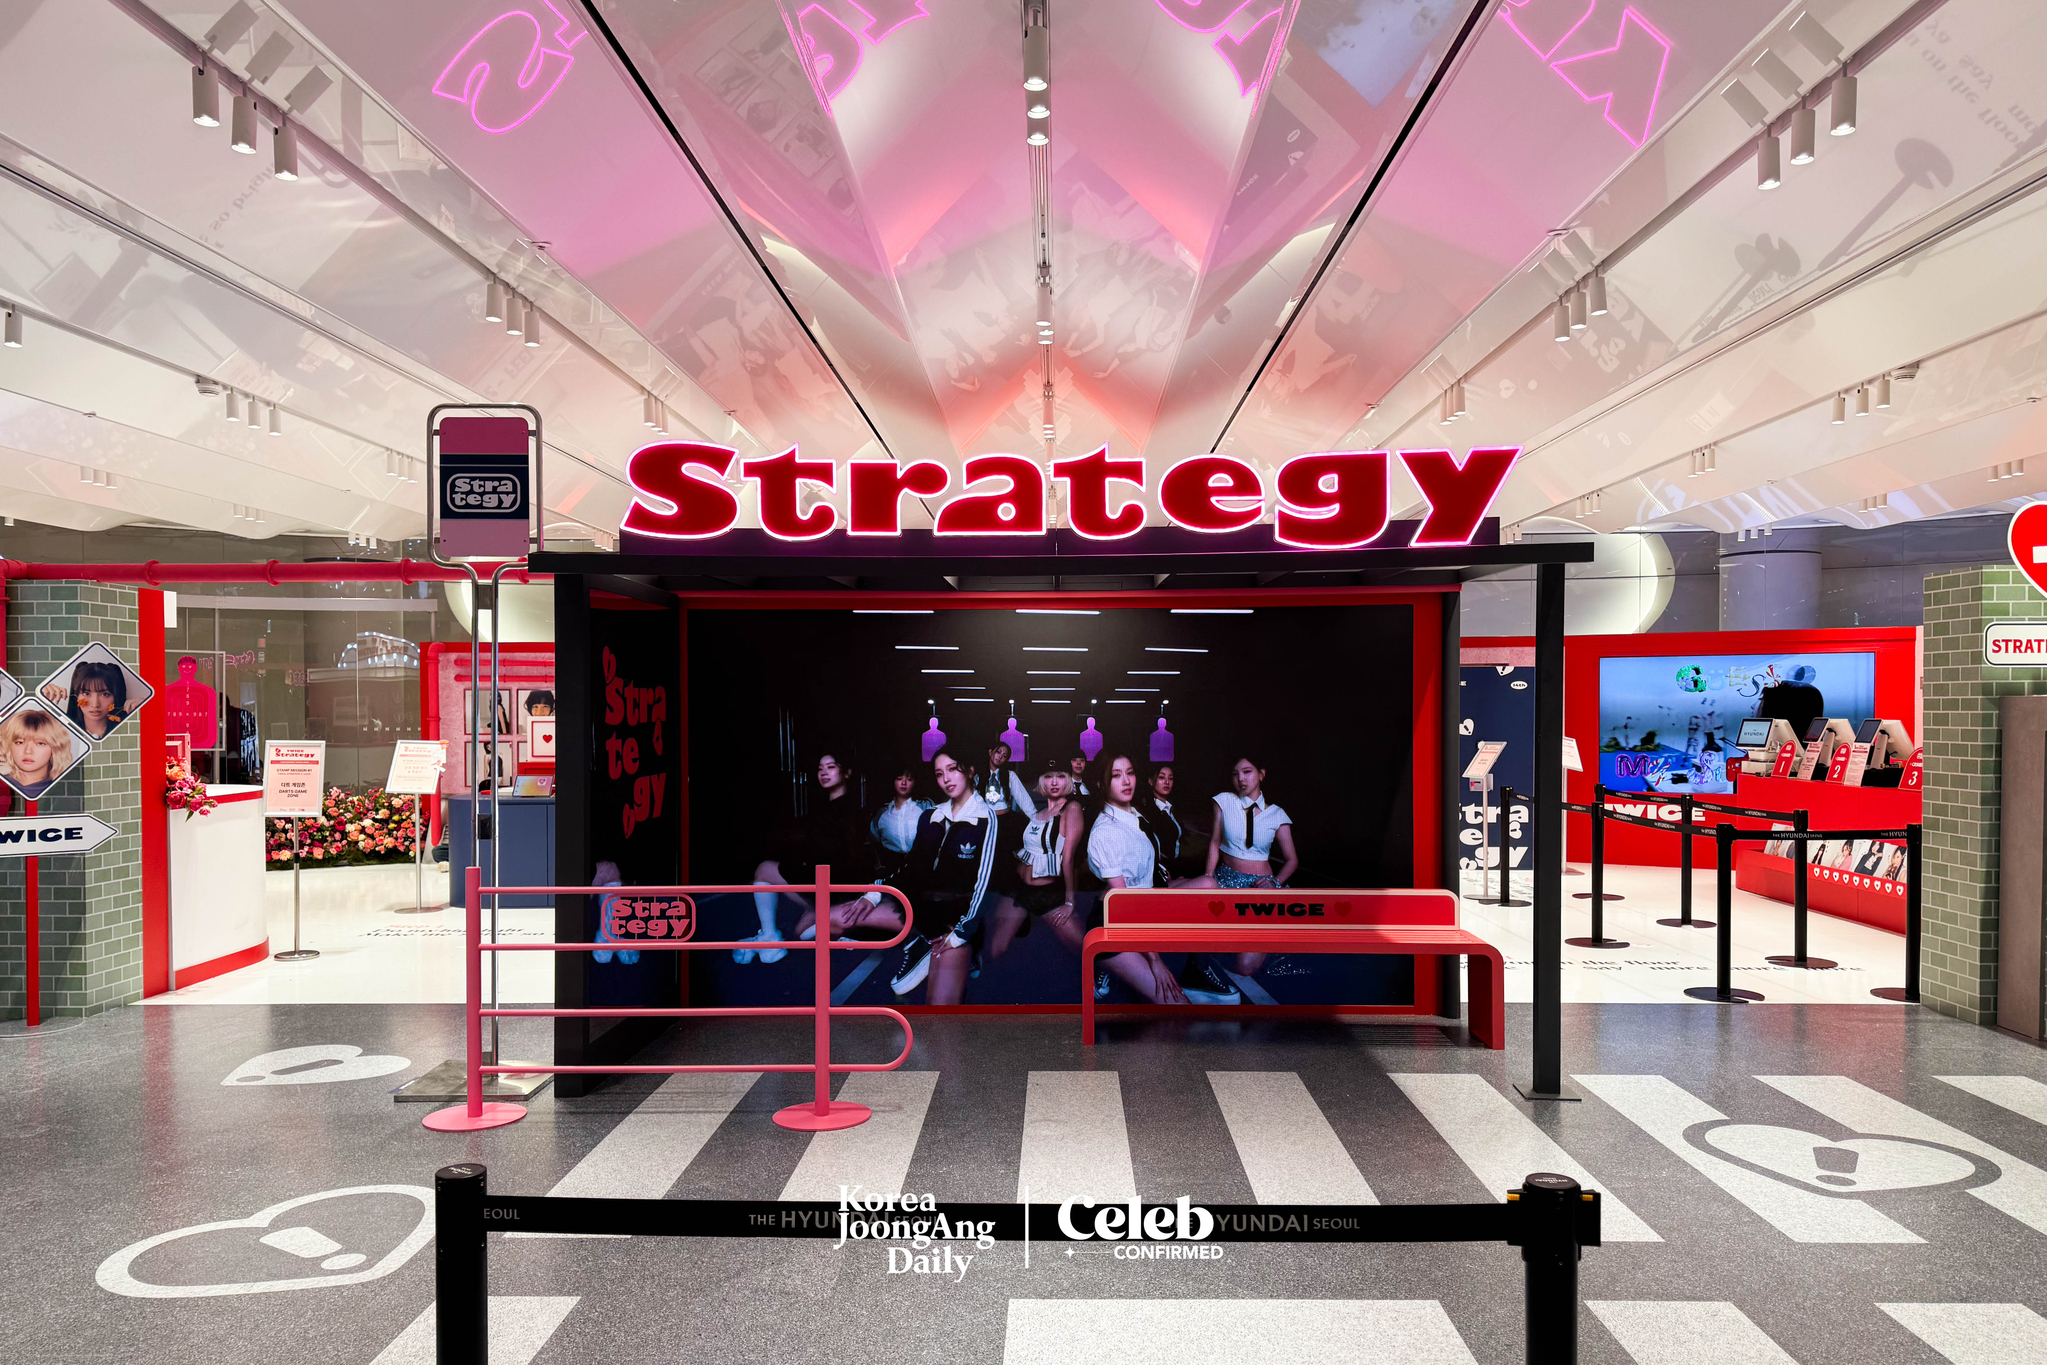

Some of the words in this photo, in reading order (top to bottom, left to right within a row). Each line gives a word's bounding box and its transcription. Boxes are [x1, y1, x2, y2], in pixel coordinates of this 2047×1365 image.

[454, 478, 513, 493] Stra
[452, 492, 516, 508] tegy
[621, 442, 1525, 550] Strategy
[1991, 639, 2047, 654] STRAT
[605, 676, 666, 726] Stra
[606, 731, 639, 780] te
[1833, 765, 1841, 778] 2
[1908, 771, 1918, 785] 3
[633, 773, 666, 822] gy
[1459, 803, 1529, 825] tra
[612, 900, 686, 917] Stra
[1235, 903, 1324, 917] TWICE
[609, 917, 690, 937] tegy
[483, 1208, 520, 1220] EOUL
[749, 1214, 776, 1225] THE
[1214, 1214, 1308, 1232] YUNDAI
[1313, 1218, 1361, 1229] SEOUL
